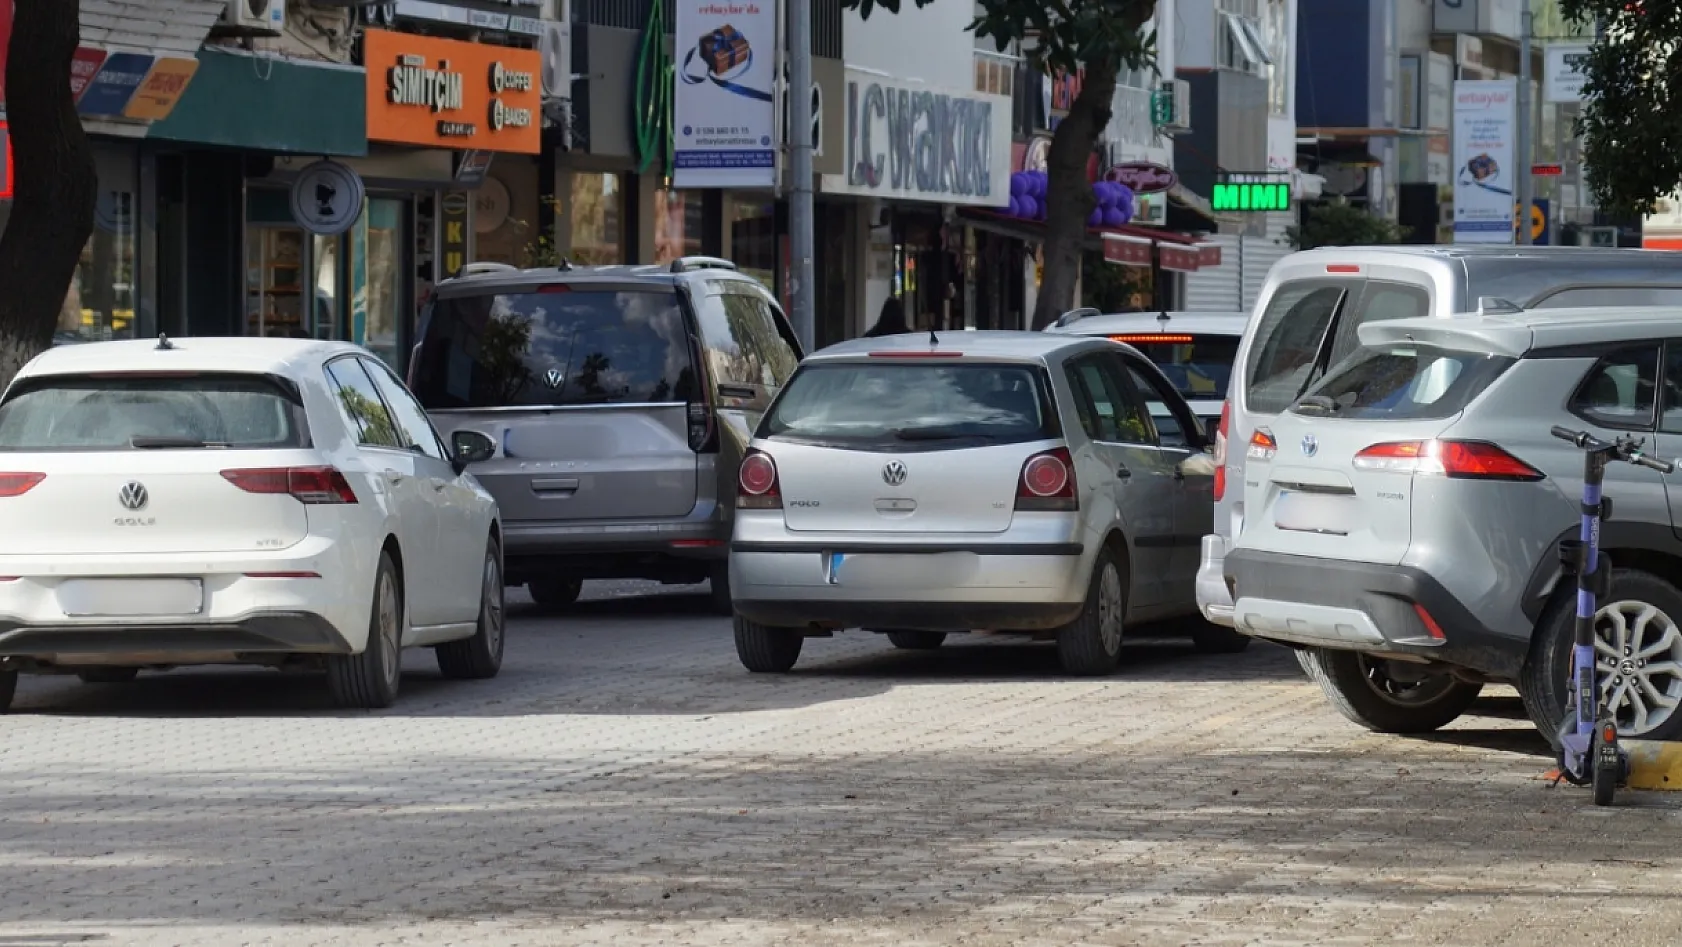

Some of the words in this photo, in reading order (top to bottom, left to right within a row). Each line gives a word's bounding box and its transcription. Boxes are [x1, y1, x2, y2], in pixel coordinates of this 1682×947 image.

[1213, 184, 1288, 209] MIMI
[789, 499, 820, 508] POLO
[113, 516, 157, 526] GOLF
